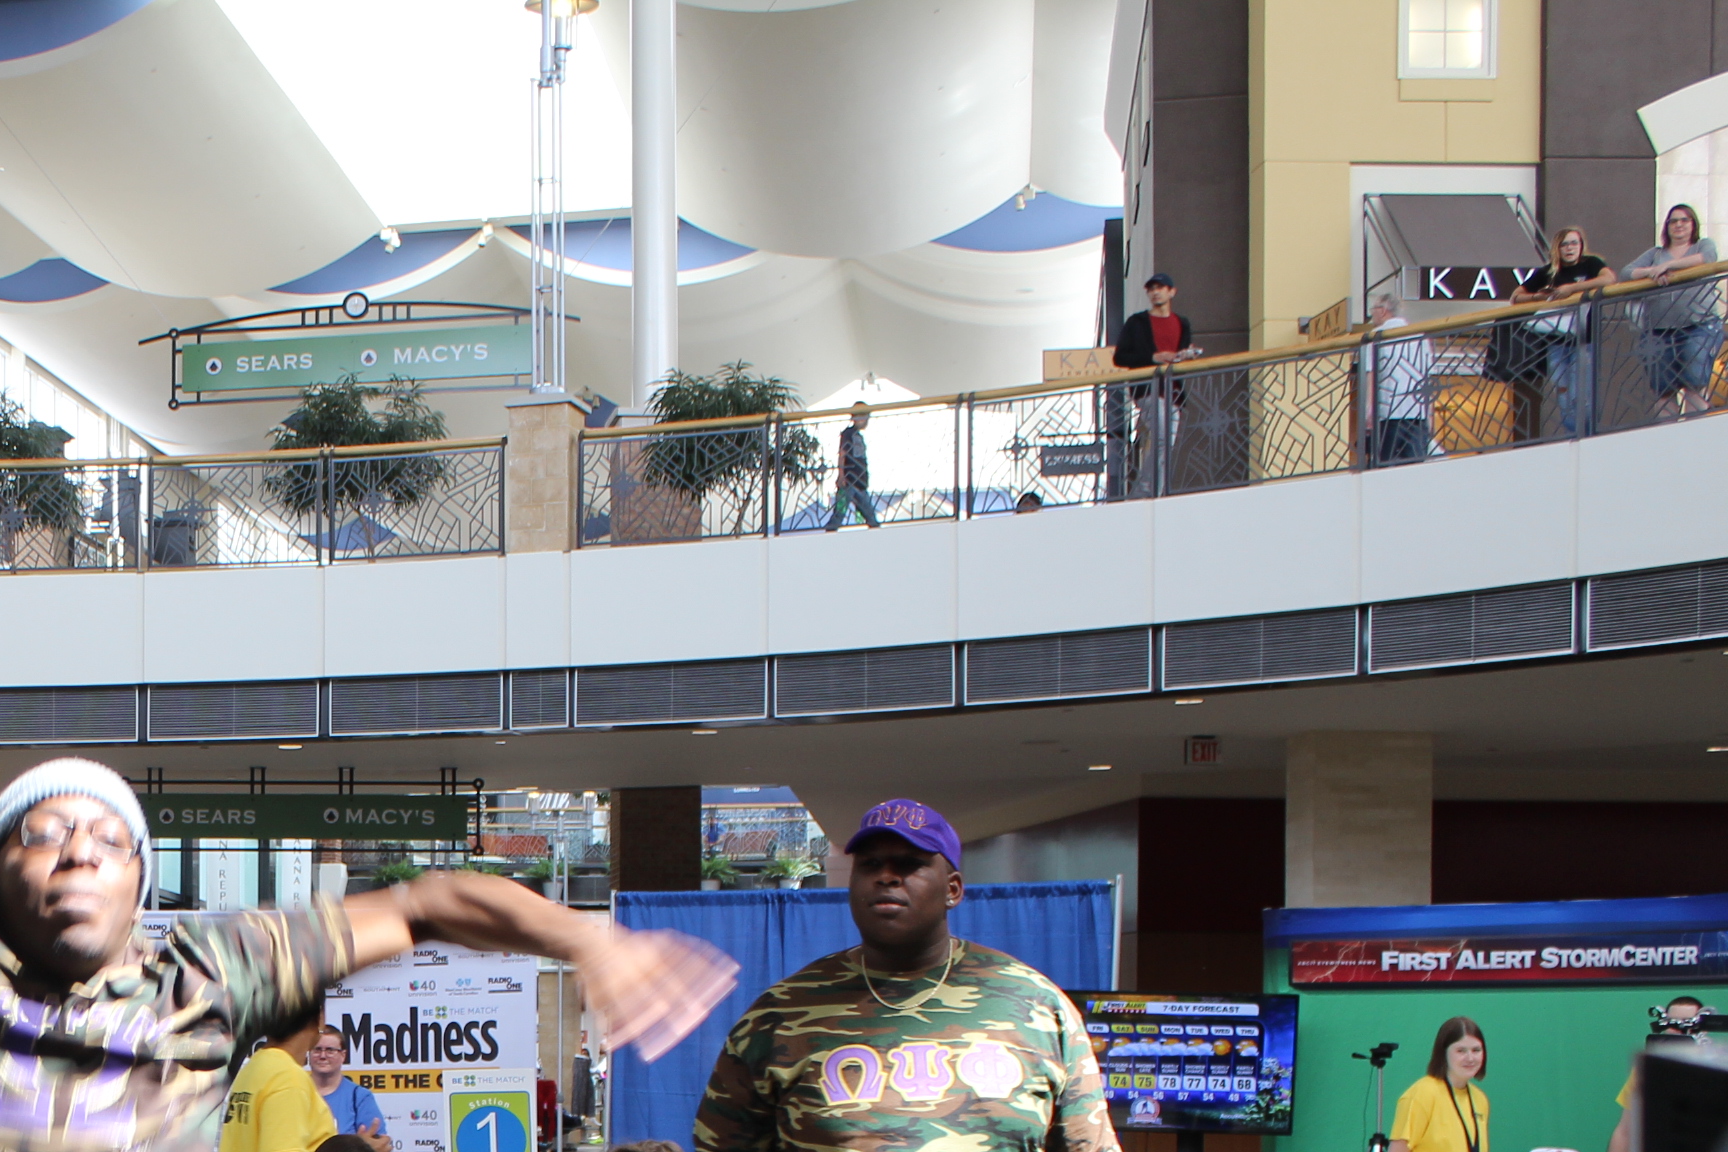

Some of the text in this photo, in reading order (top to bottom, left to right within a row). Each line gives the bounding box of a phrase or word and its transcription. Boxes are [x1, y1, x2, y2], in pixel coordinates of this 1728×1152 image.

[236, 343, 489, 373] SEARS MACY'S
[181, 808, 436, 825] SEARS MACY'S
[413, 950, 438, 958] RADIO
[1381, 950, 1450, 972] FIRST
[1455, 950, 1536, 970] ALERT
[420, 980, 436, 991] 40
[488, 976, 512, 984] RADIO
[337, 987, 354, 996] ONE
[507, 982, 522, 990] ONE
[449, 1007, 465, 1015] THE
[468, 1006, 498, 1015] MATCH
[1163, 1003, 1240, 1013] 7-DAY FORECAST
[341, 1007, 499, 1065] Madness
[818, 1041, 1023, 1106] ΩΨΦ
[360, 1074, 387, 1089] BE
[391, 1073, 431, 1089] THE
[1113, 1076, 1251, 1090] 74 75 78 77 74 68
[469, 1097, 510, 1110] Station
[421, 1110, 437, 1120] 40
[415, 1139, 440, 1147] RADIO
